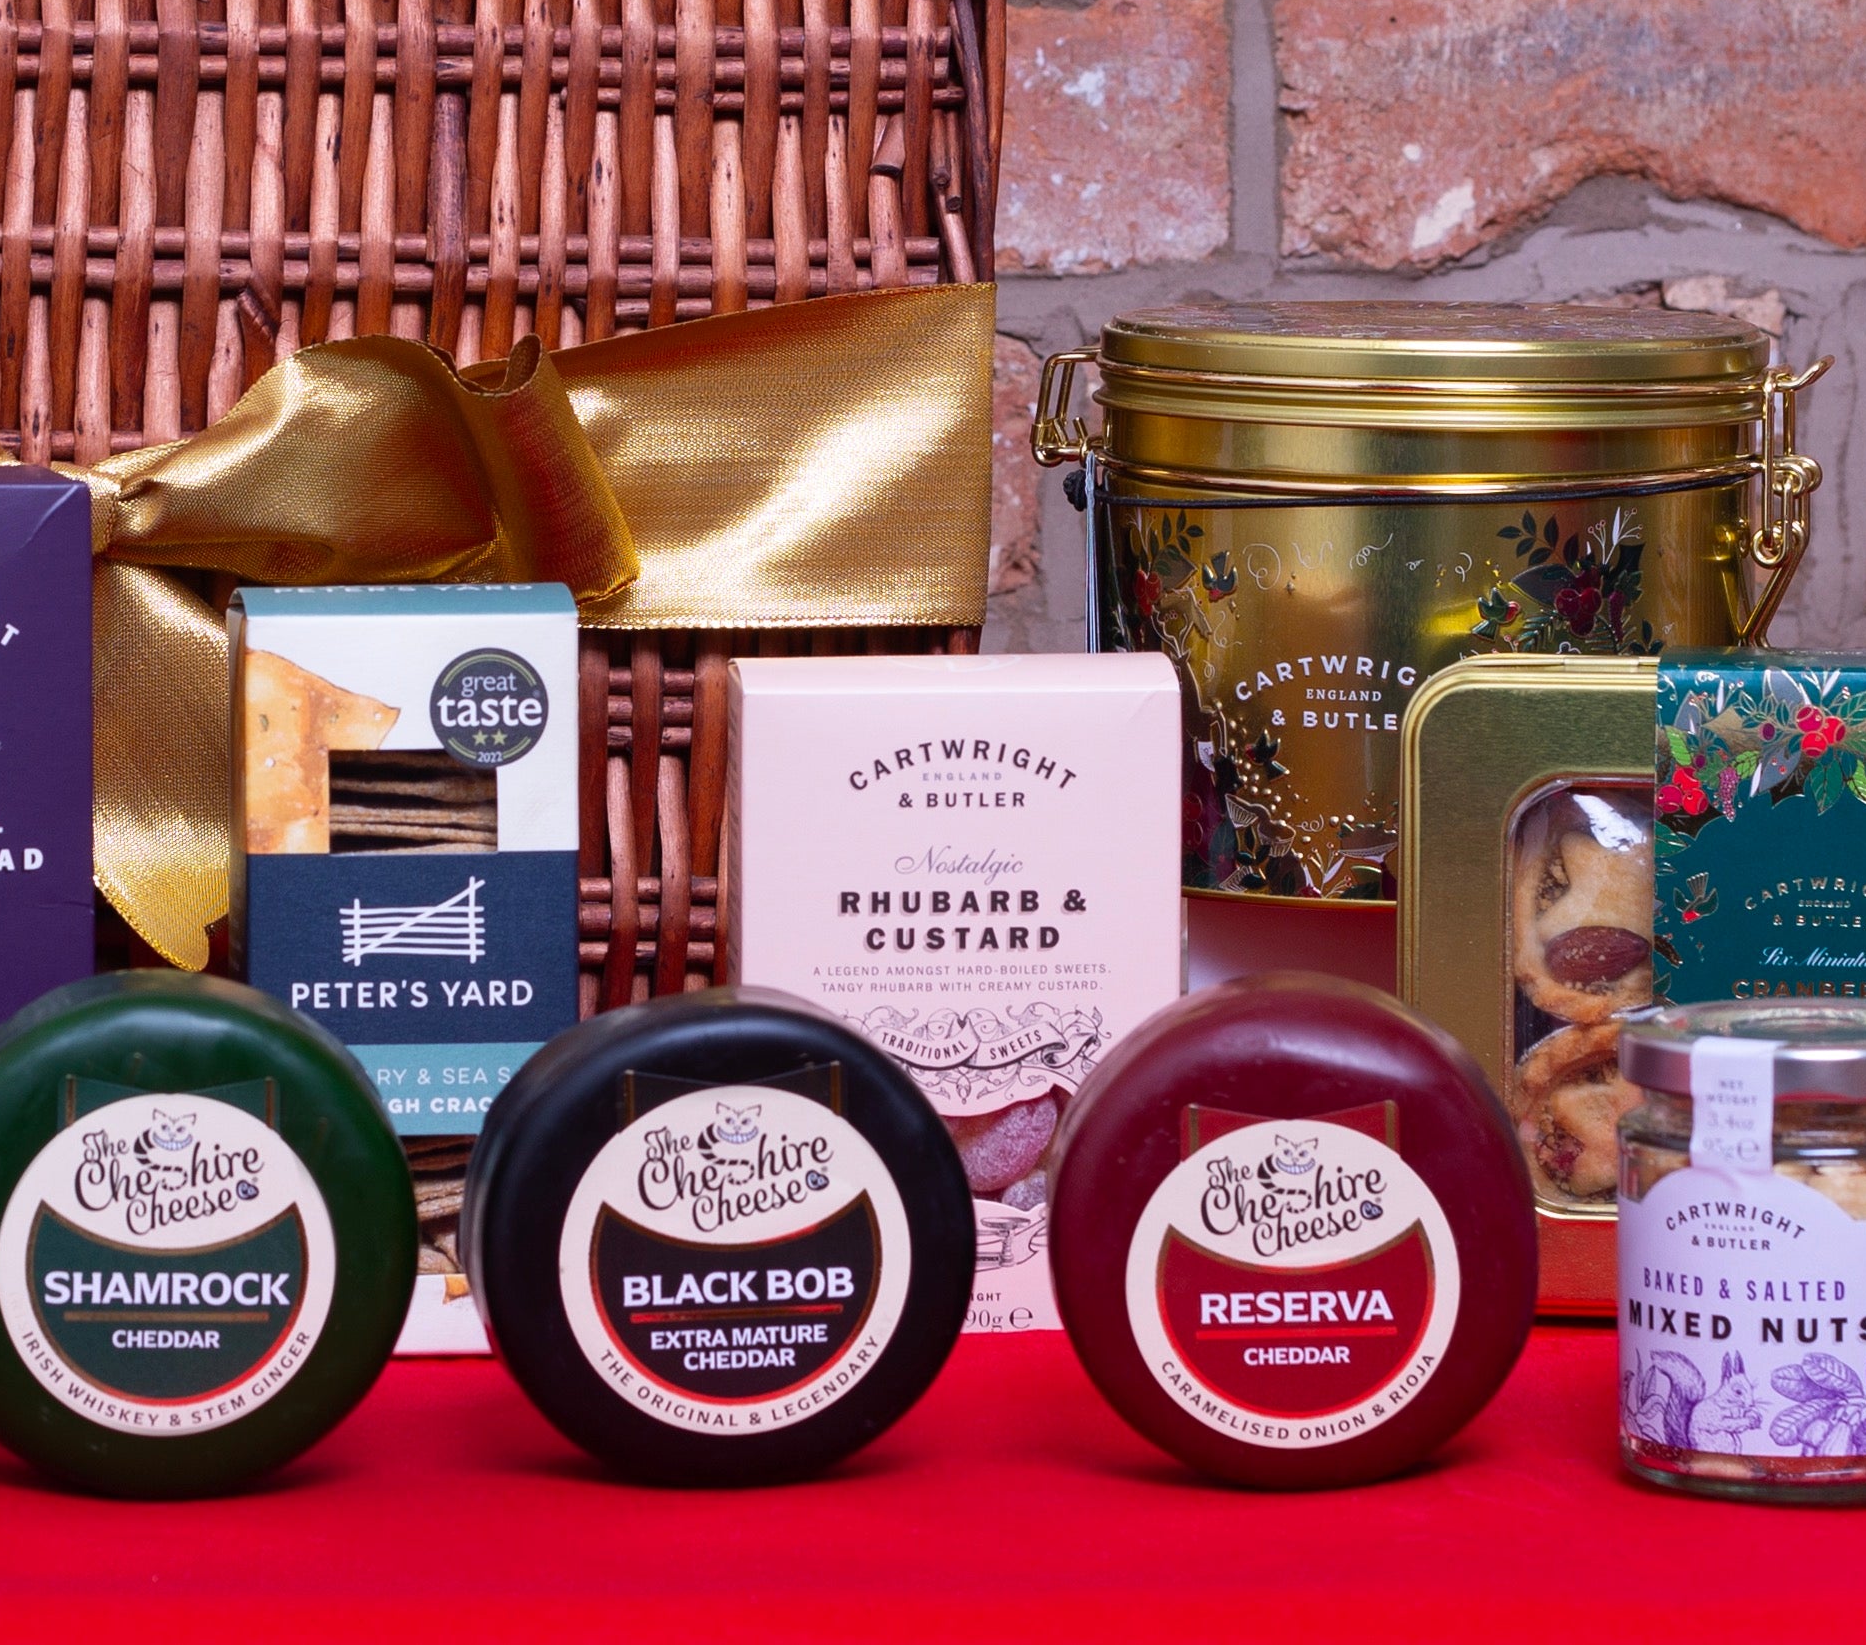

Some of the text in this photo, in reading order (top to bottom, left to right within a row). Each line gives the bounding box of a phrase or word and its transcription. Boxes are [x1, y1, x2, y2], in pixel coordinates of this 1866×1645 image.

[460, 671, 518, 697] great
[1235, 654, 1420, 701] CARTWRIG
[435, 693, 544, 728] taste
[1305, 688, 1383, 702] ENGLAND
[1271, 709, 1399, 731] & BUTLE
[848, 737, 1078, 792] CARTWRIGHT
[921, 771, 1004, 782] ENGLAND
[898, 791, 1027, 808] & BUTLER
[894, 845, 1024, 886] Nostalgic
[837, 888, 1088, 915] RHUBARB &
[864, 926, 1062, 952] CUSTARD
[291, 978, 534, 1009] PETER'S YARD
[881, 1028, 1043, 1061] TRADITIONAL SWEETS
[1665, 1201, 1806, 1240] CARTWRIGHT
[43, 1269, 291, 1308] SHAMROCK
[622, 1266, 855, 1308] BLACK BOB
[1642, 1266, 1847, 1303] BAKED & SALTED
[1199, 1288, 1395, 1326] RESERVA
[1628, 1298, 1734, 1340] MIXED
[111, 1329, 221, 1350] CHEDDAR
[650, 1323, 829, 1351] EXTRA MATURE
[682, 1348, 797, 1373] CHEDDAR
[1243, 1346, 1352, 1368] CHEDDAR
[22, 1329, 311, 1428] IRISH WHISKEY & STEM GINGER
[598, 1334, 881, 1428] THE ORIGINAL & LEGENDARY
[1160, 1351, 1437, 1442] CARAMELISED ONION & RIOJA
